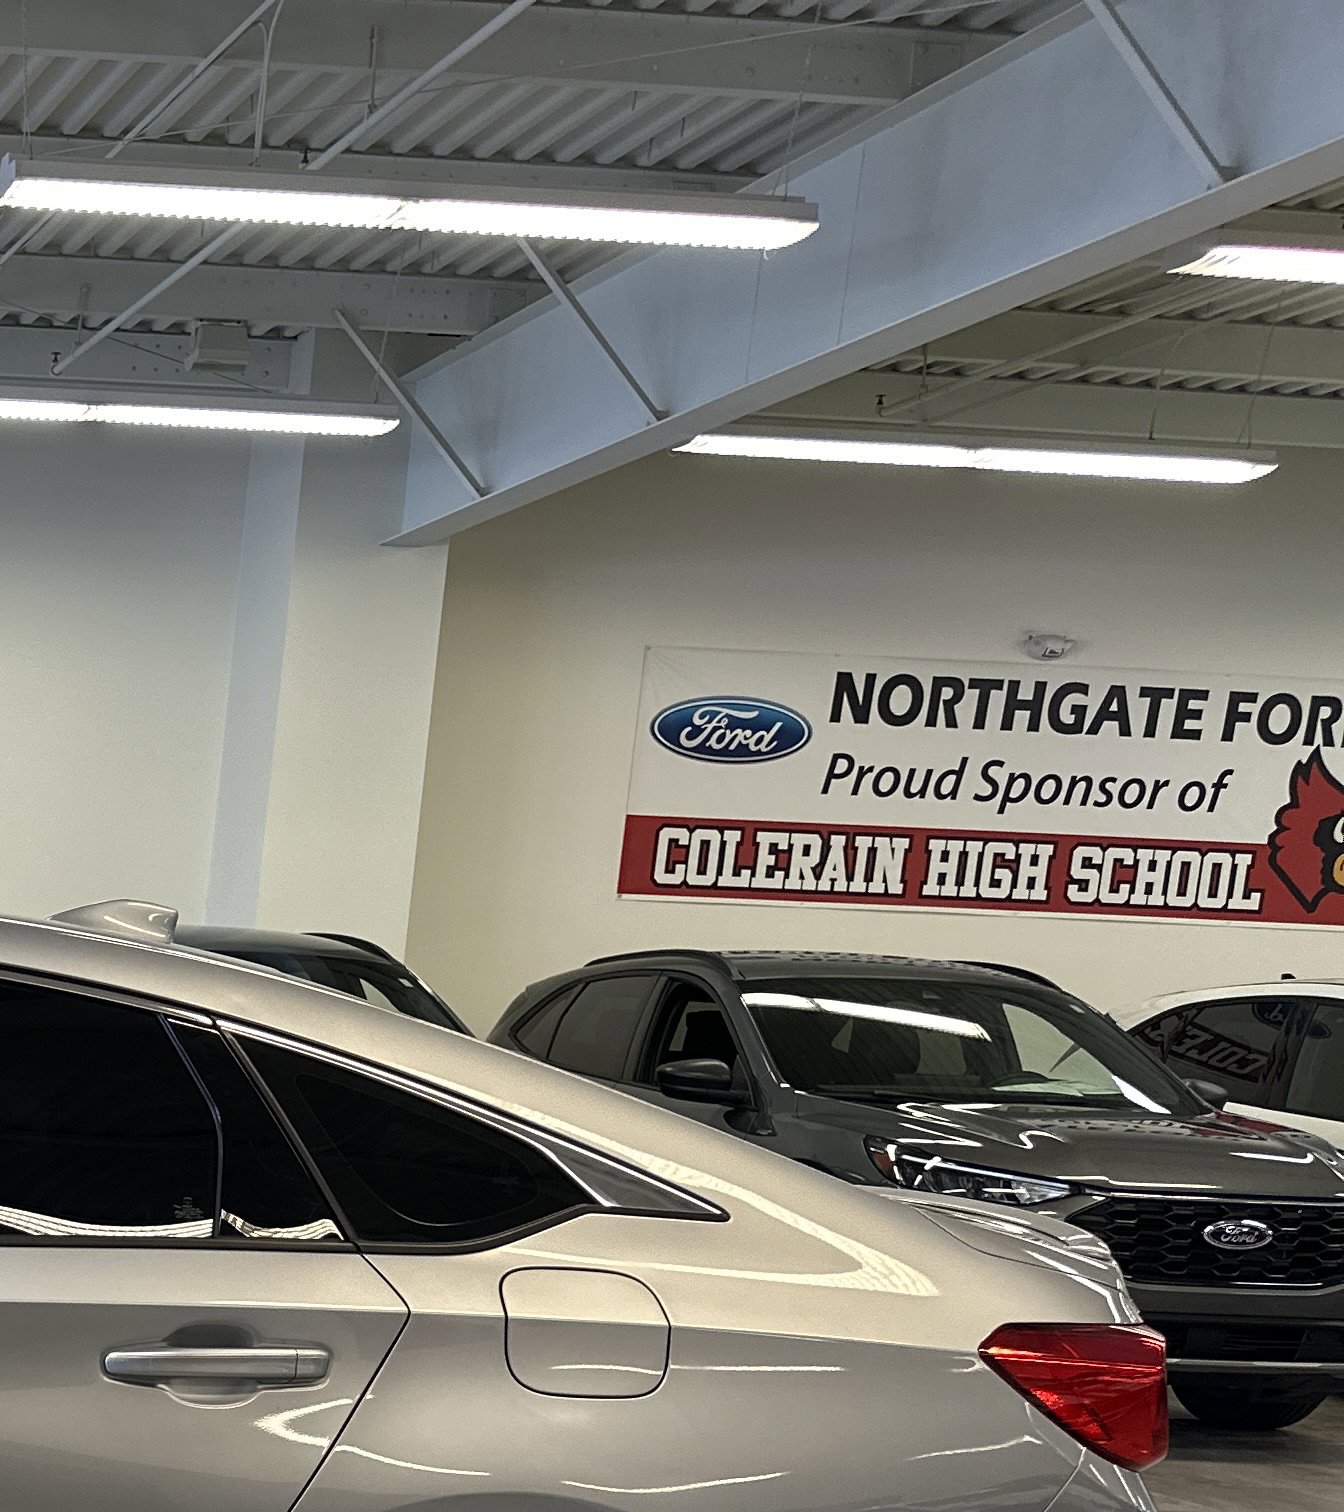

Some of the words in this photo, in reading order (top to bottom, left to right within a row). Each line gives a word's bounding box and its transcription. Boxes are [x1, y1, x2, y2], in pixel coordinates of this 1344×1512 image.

[679, 704, 783, 753] Ford
[828, 671, 1210, 742] NORTHGATE
[1220, 690, 1344, 749] FOR
[820, 753, 969, 802] Proud
[972, 759, 1171, 815] Sponsor
[1177, 768, 1235, 813] of
[652, 826, 911, 896] COLERAIN
[920, 838, 1054, 902] HIGH
[1065, 844, 1263, 912] SCHOOL
[1219, 1225, 1259, 1243] Ford
